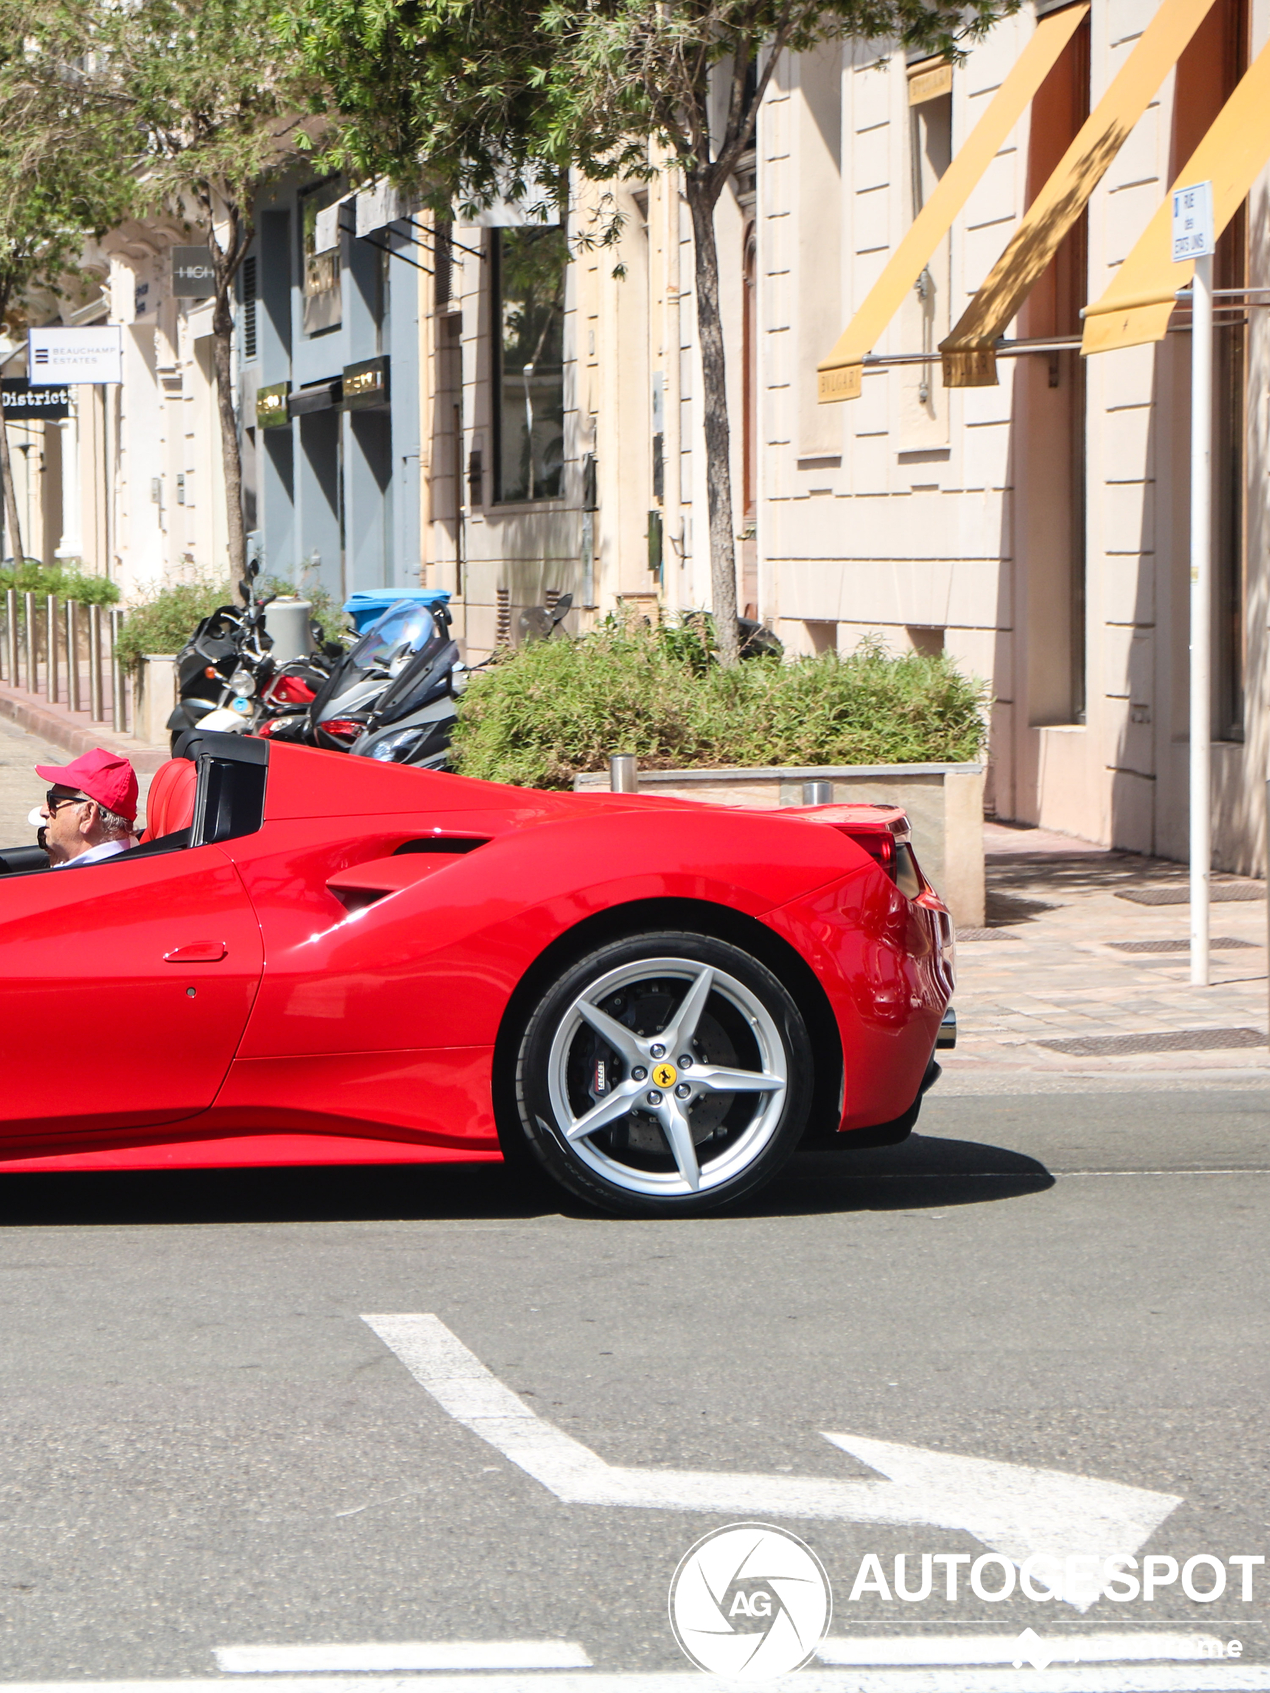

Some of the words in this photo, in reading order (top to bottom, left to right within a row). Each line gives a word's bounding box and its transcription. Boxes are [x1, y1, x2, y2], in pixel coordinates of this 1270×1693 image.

[52, 347, 116, 356] BEAUCHAMP
[53, 357, 98, 365] ESTATES
[1, 389, 68, 407] District
